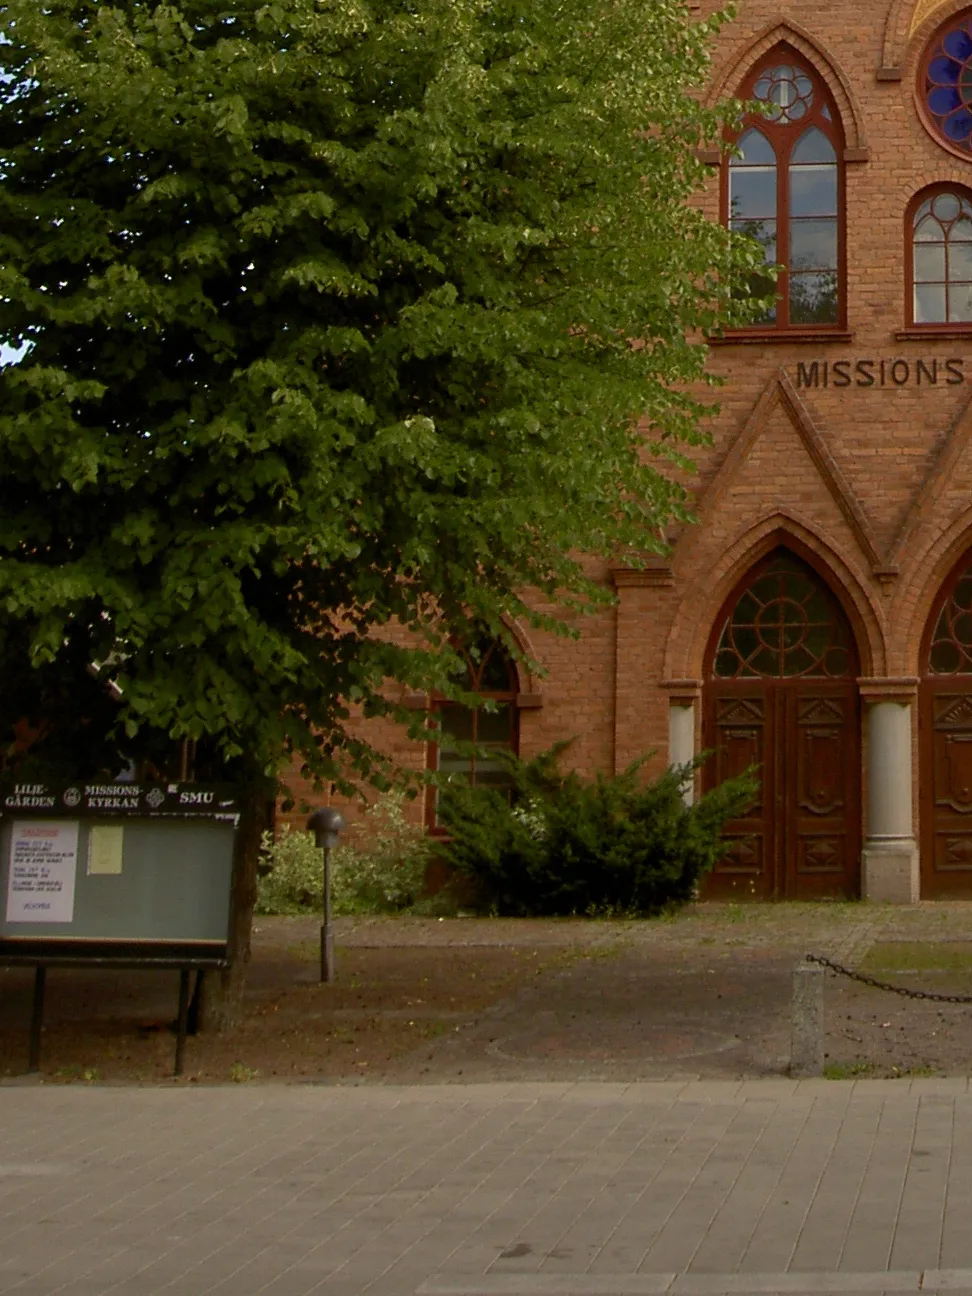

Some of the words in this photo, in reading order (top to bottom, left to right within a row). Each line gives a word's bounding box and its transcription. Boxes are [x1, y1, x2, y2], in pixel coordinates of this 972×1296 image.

[797, 358, 965, 388] MISSIONS
[14, 784, 48, 795] LILJE-
[84, 784, 143, 796] MISSIONS-
[5, 794, 55, 807] GÅRDEN
[87, 796, 139, 808] KYRKAN
[179, 791, 214, 804] SMU
